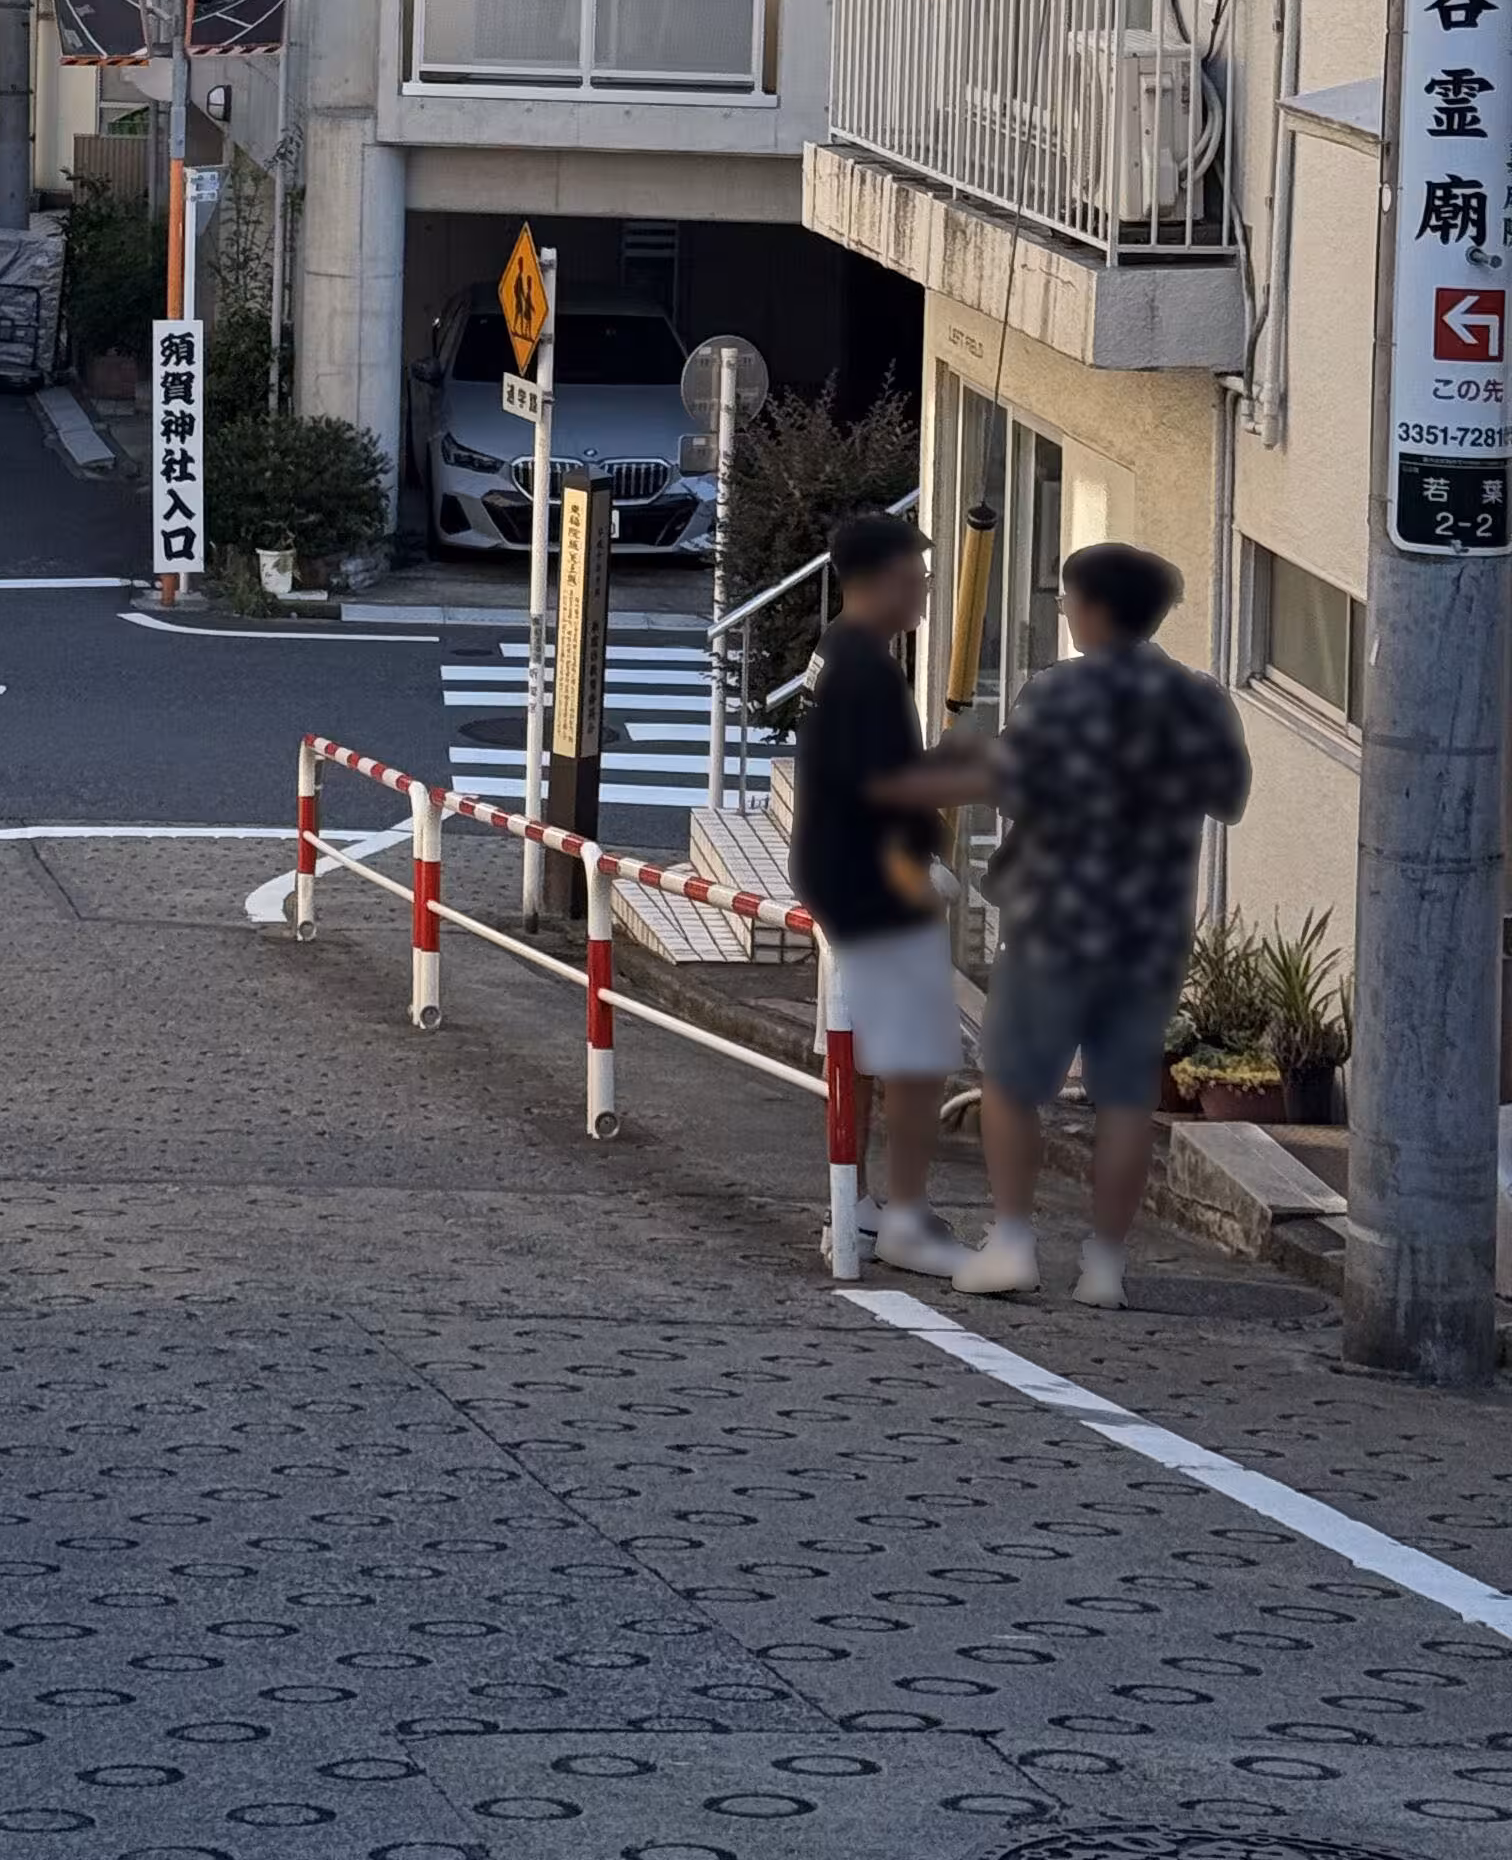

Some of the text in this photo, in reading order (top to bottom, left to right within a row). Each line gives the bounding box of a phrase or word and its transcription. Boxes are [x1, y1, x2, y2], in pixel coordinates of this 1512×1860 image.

[1432, 378, 1504, 403] この先
[160, 332, 196, 561] 須賀神社入口
[1398, 422, 1502, 448] 3351-7281
[1422, 476, 1504, 504] 若葉
[1435, 512, 1493, 537] 2-2
